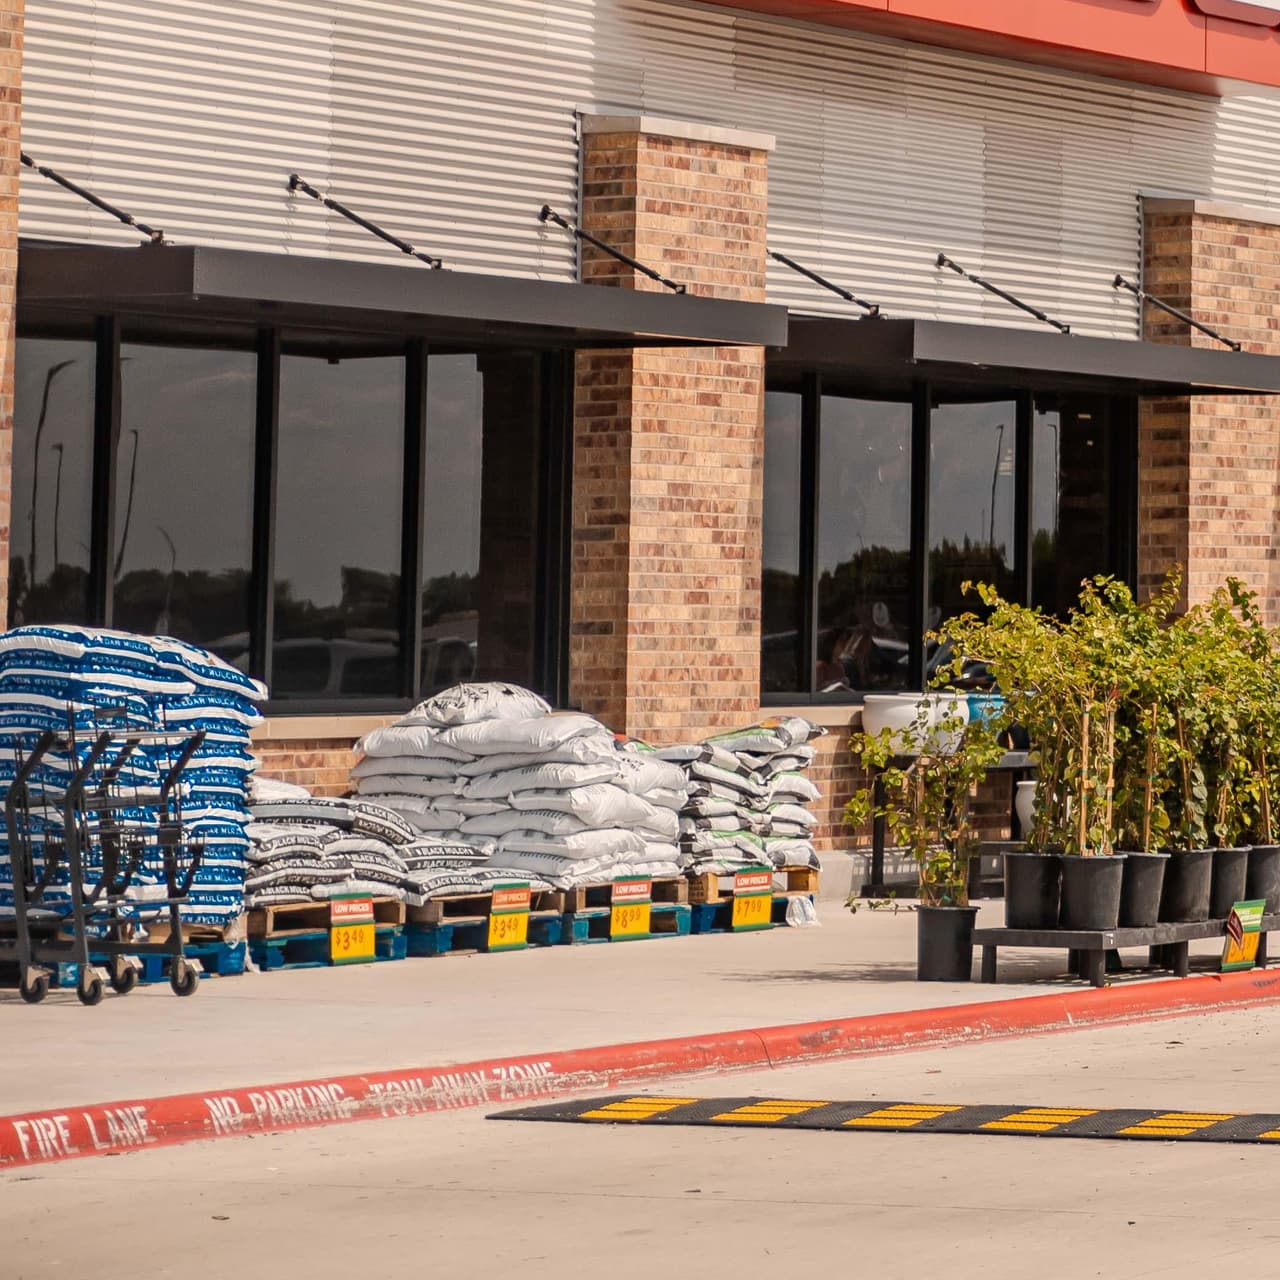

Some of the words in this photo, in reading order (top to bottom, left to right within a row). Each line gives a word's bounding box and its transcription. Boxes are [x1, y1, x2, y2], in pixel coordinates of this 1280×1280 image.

[421, 847, 445, 856] BLACK
[445, 847, 470, 855] MULCH
[350, 854, 375, 863] BLACK
[736, 877, 749, 886] LOW
[750, 875, 769, 885] PRICES
[265, 886, 286, 895] BLACK
[615, 885, 628, 894] LOW
[629, 883, 648, 893] PRICES
[334, 903, 348, 914] LOW
[349, 902, 370, 913] PRICES
[12, 1115, 81, 1161] FIRE
[83, 1106, 157, 1150] LANE
[203, 1096, 242, 1135] NO
[248, 1083, 352, 1125] PARKING
